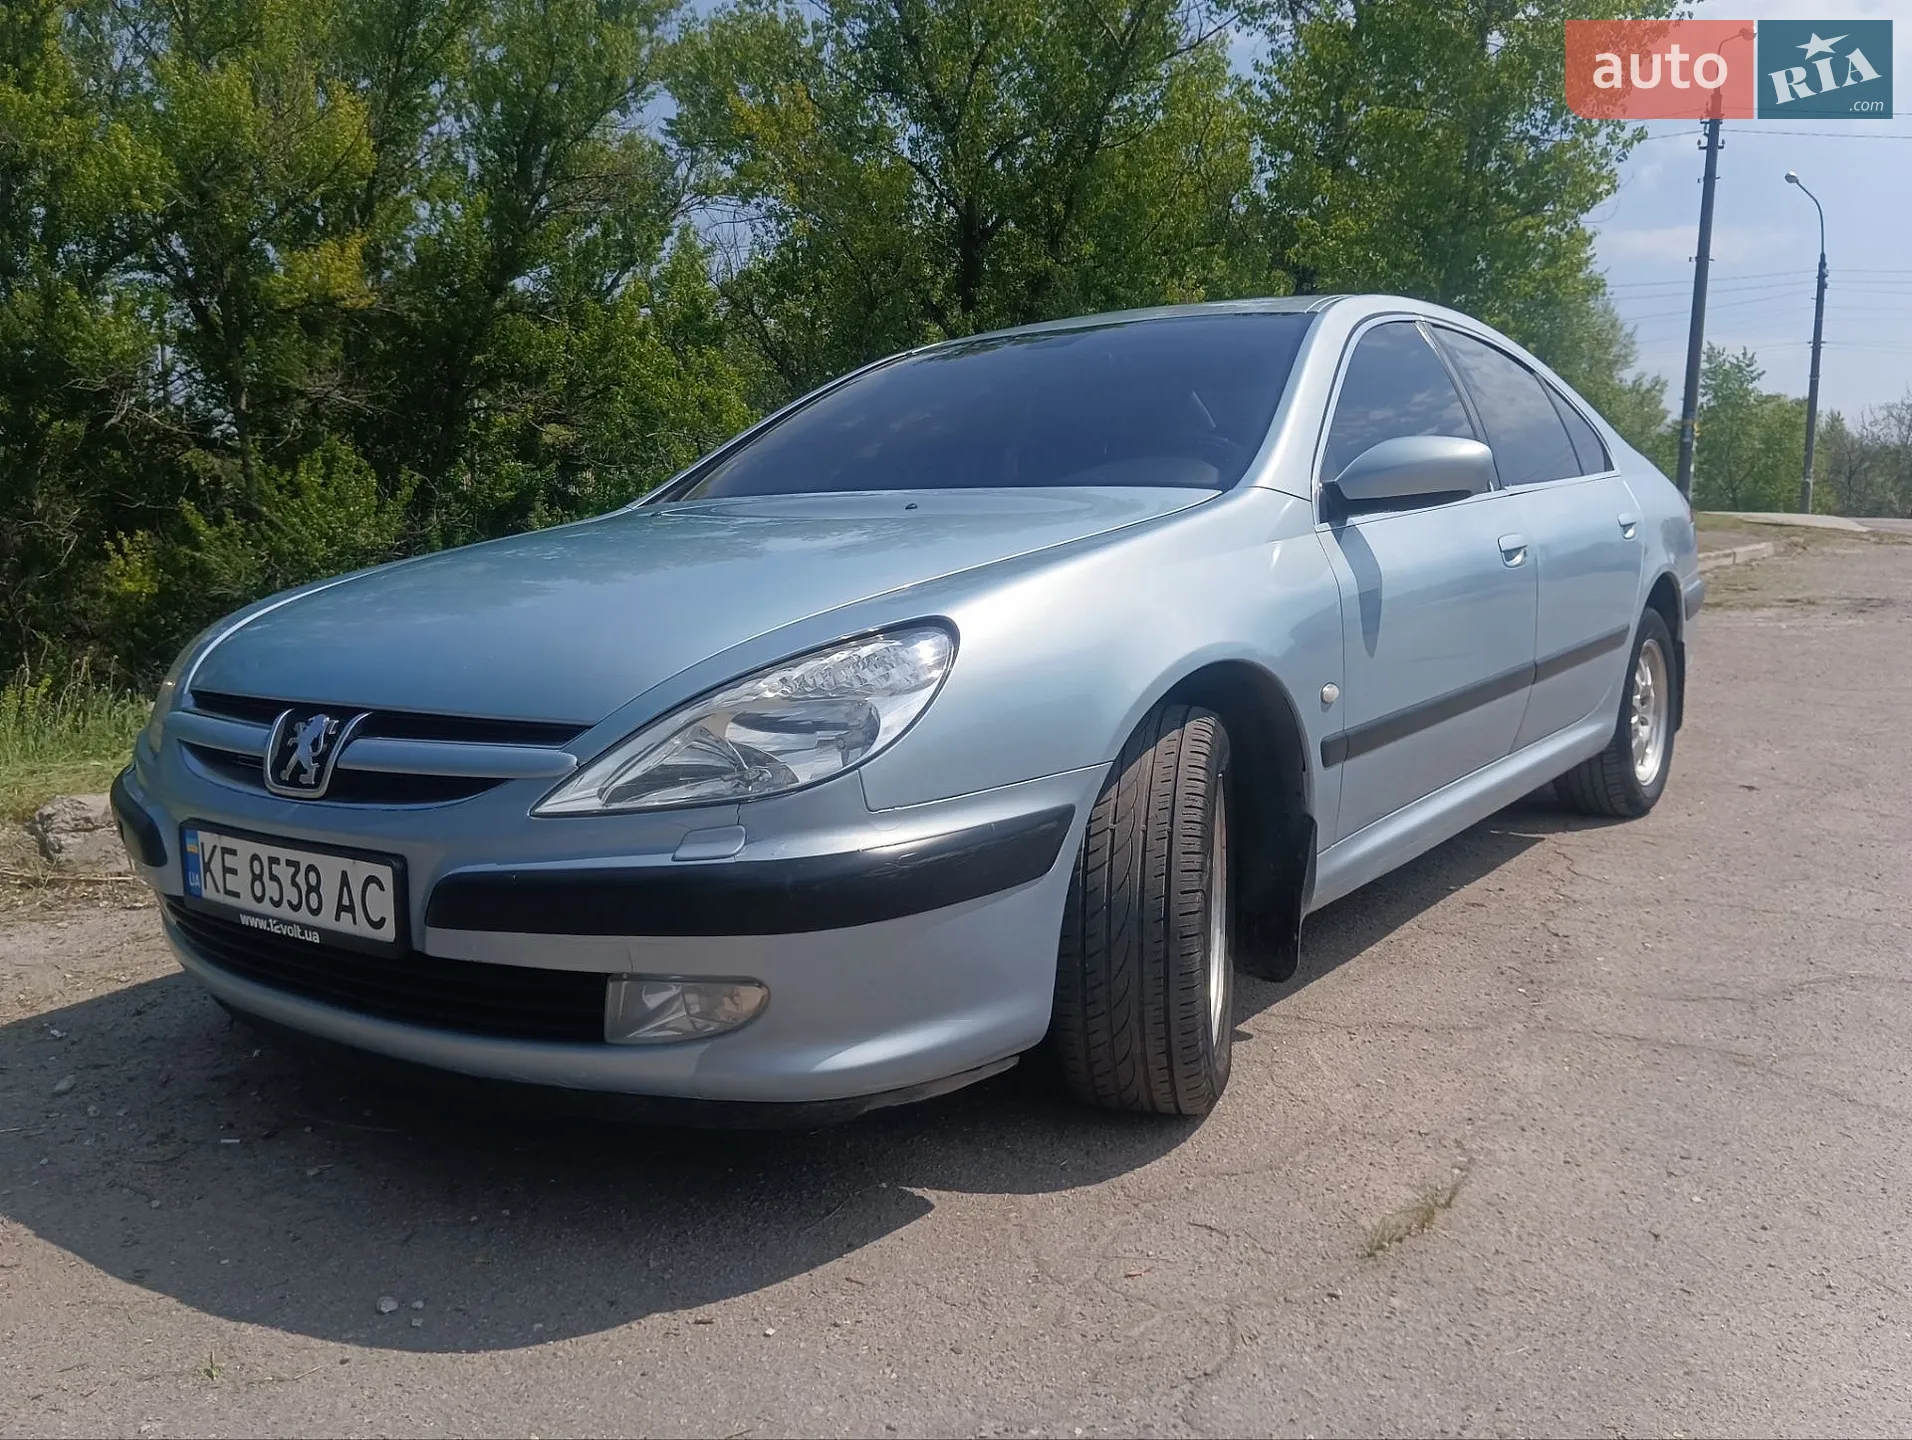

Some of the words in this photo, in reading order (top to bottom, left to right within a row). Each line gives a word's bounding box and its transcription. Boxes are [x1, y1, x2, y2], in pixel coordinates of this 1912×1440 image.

[188, 872, 200, 887] UA
[200, 841, 241, 899] KE
[250, 853, 323, 917] 8538
[334, 870, 387, 930] AC
[239, 913, 320, 944] www.12volt.ua
